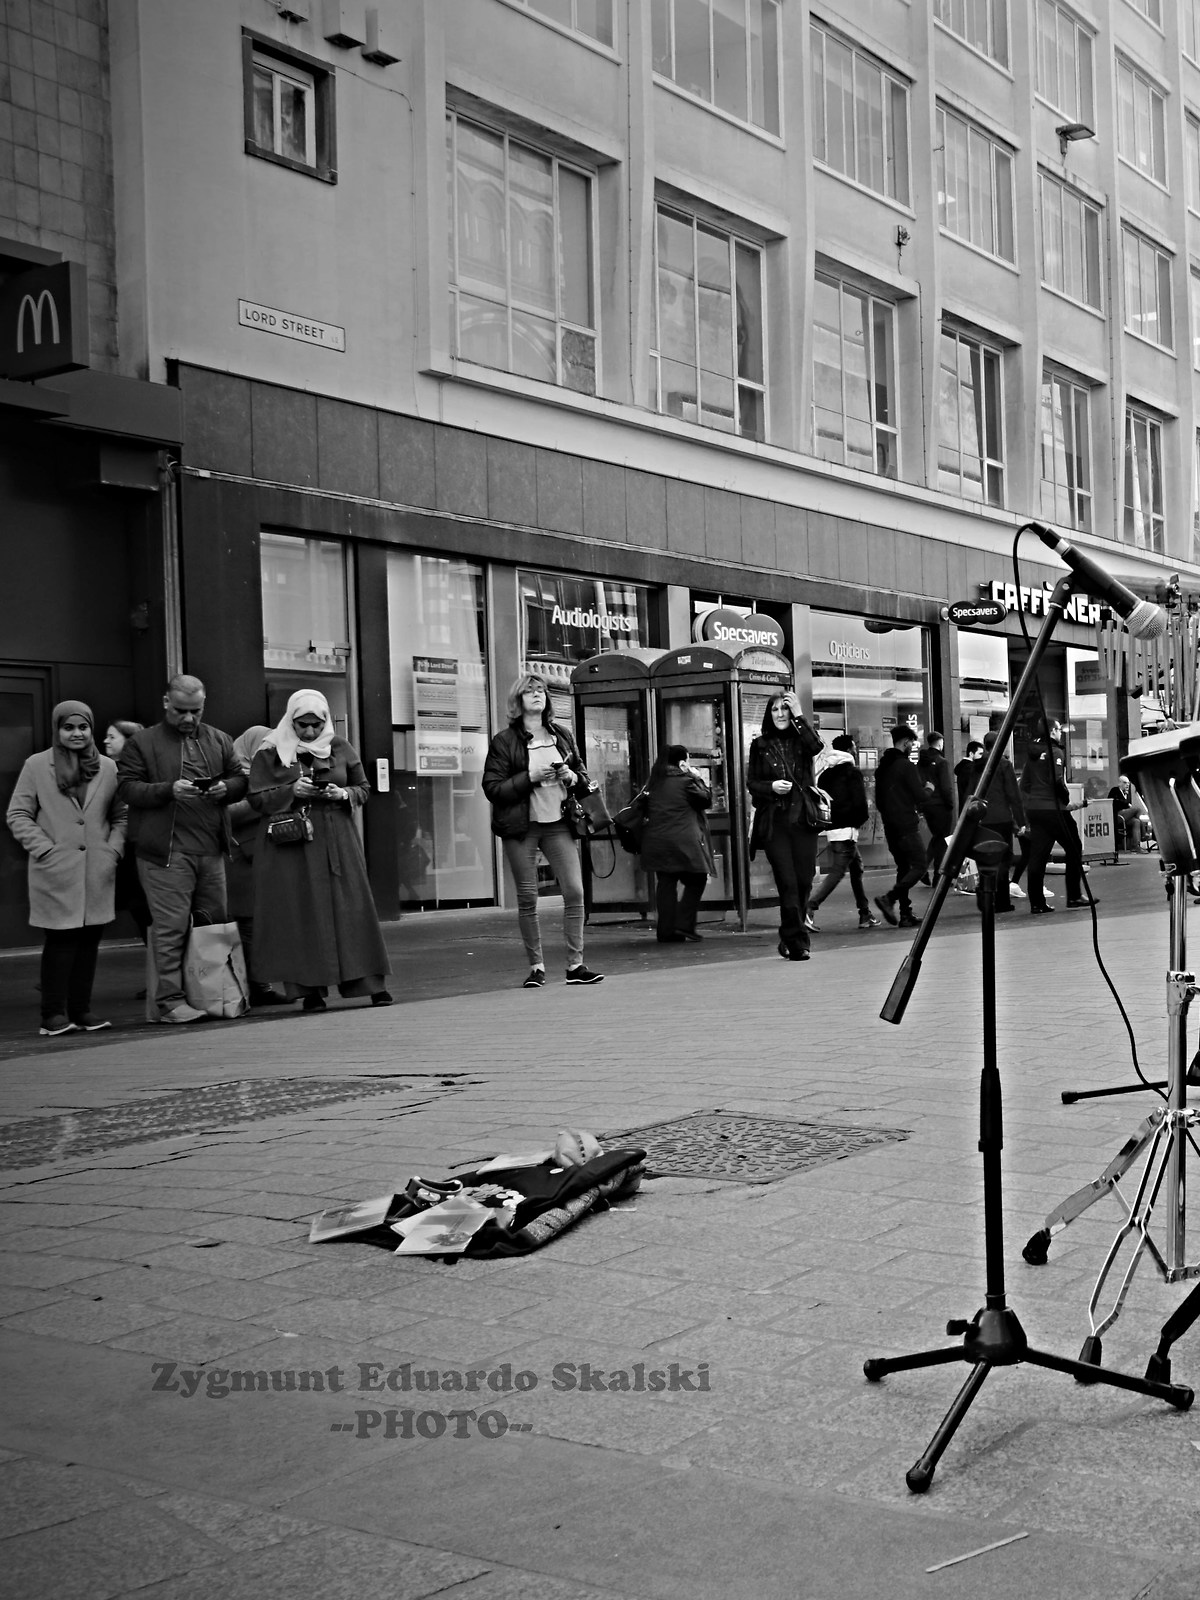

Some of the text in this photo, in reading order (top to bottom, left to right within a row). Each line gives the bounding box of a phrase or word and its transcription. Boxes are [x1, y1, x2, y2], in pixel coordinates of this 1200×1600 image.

[245, 308, 277, 326] LORD
[282, 319, 325, 340] STREET
[551, 604, 632, 635] Audiologists
[952, 606, 998, 619] Specsavers
[1064, 594, 1101, 625] NER
[713, 621, 778, 646] Specsavers
[829, 640, 870, 660] Opticians
[1084, 822, 1110, 838] NERO
